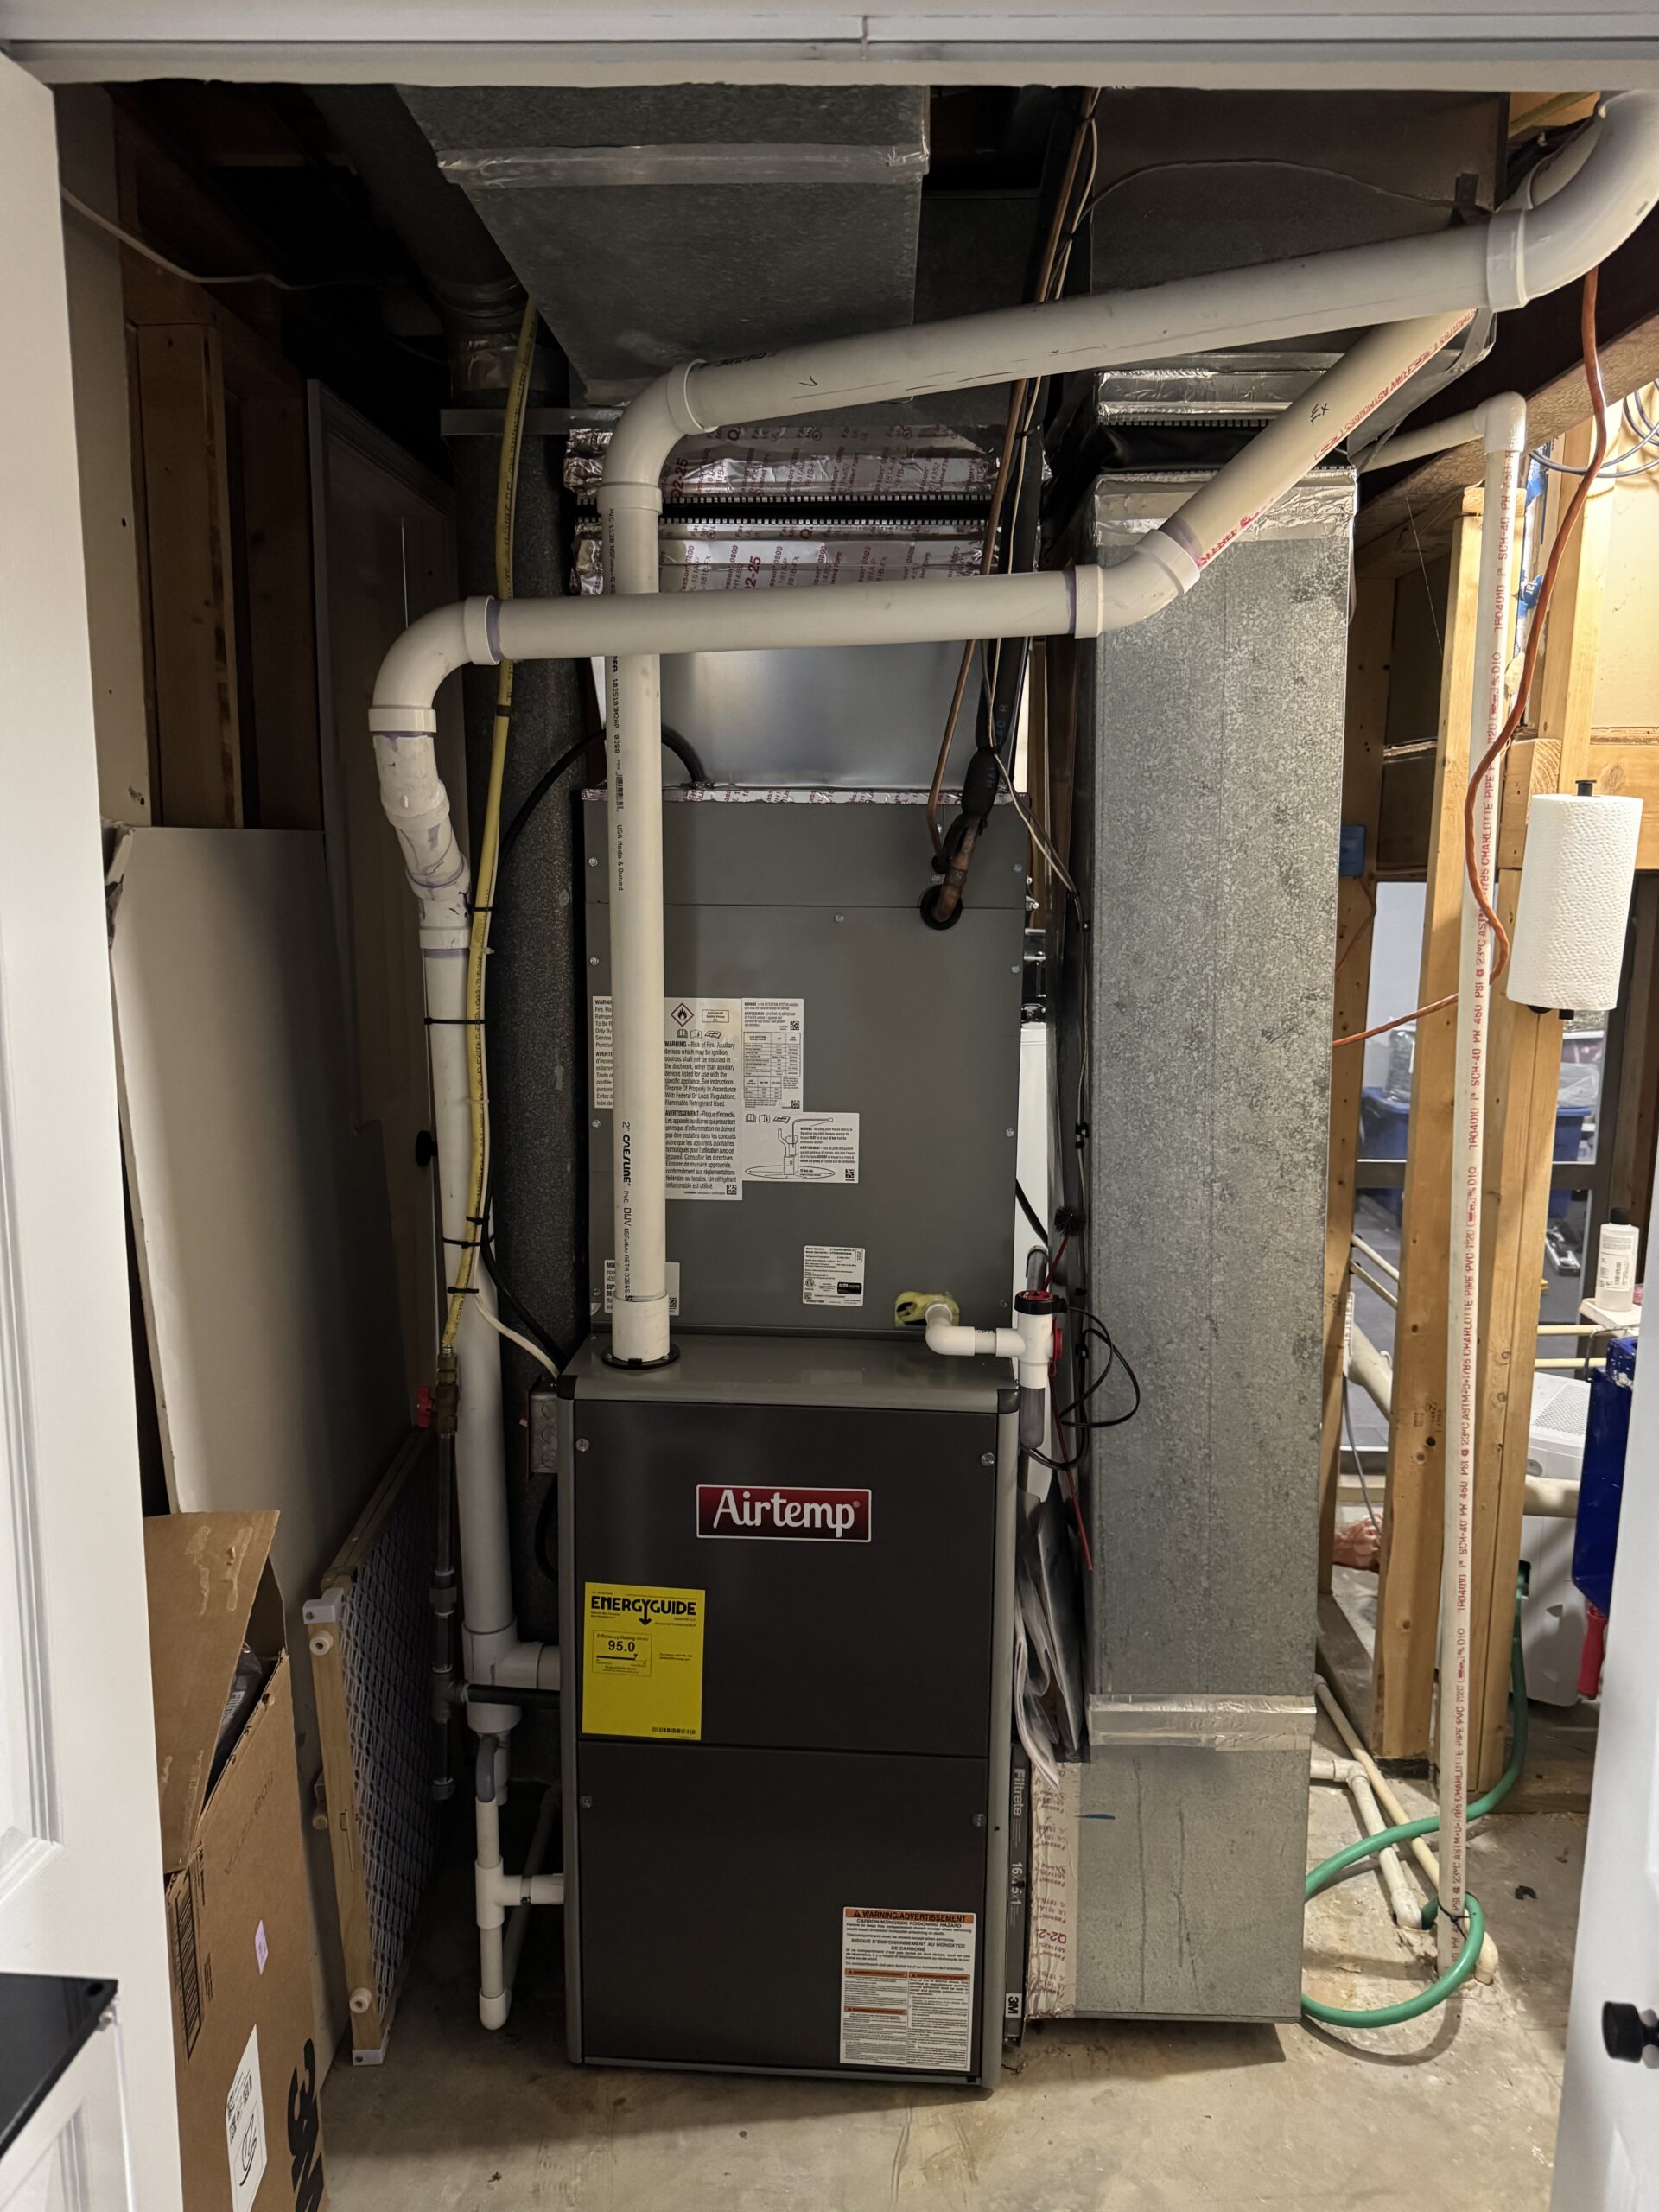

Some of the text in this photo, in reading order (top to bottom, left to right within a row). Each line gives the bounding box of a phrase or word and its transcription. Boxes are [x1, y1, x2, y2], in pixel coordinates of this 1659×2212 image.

[1310, 403, 1329, 425] Ex
[1497, 518, 1510, 559] SCH-40
[745, 556, 761, 588] 2-25
[1484, 776, 1495, 798] PIPE
[1482, 804, 1493, 865] CHARLOTTE
[1472, 1030, 1481, 1043] PR
[1471, 1049, 1481, 1086] SCH-40
[623, 1207, 632, 1227] DWV
[591, 1595, 696, 1617] ENERGYGUIDE
[608, 1640, 635, 1652] 95.0
[1007, 1769, 1026, 2014] Filtrete 16x5x1 3M
